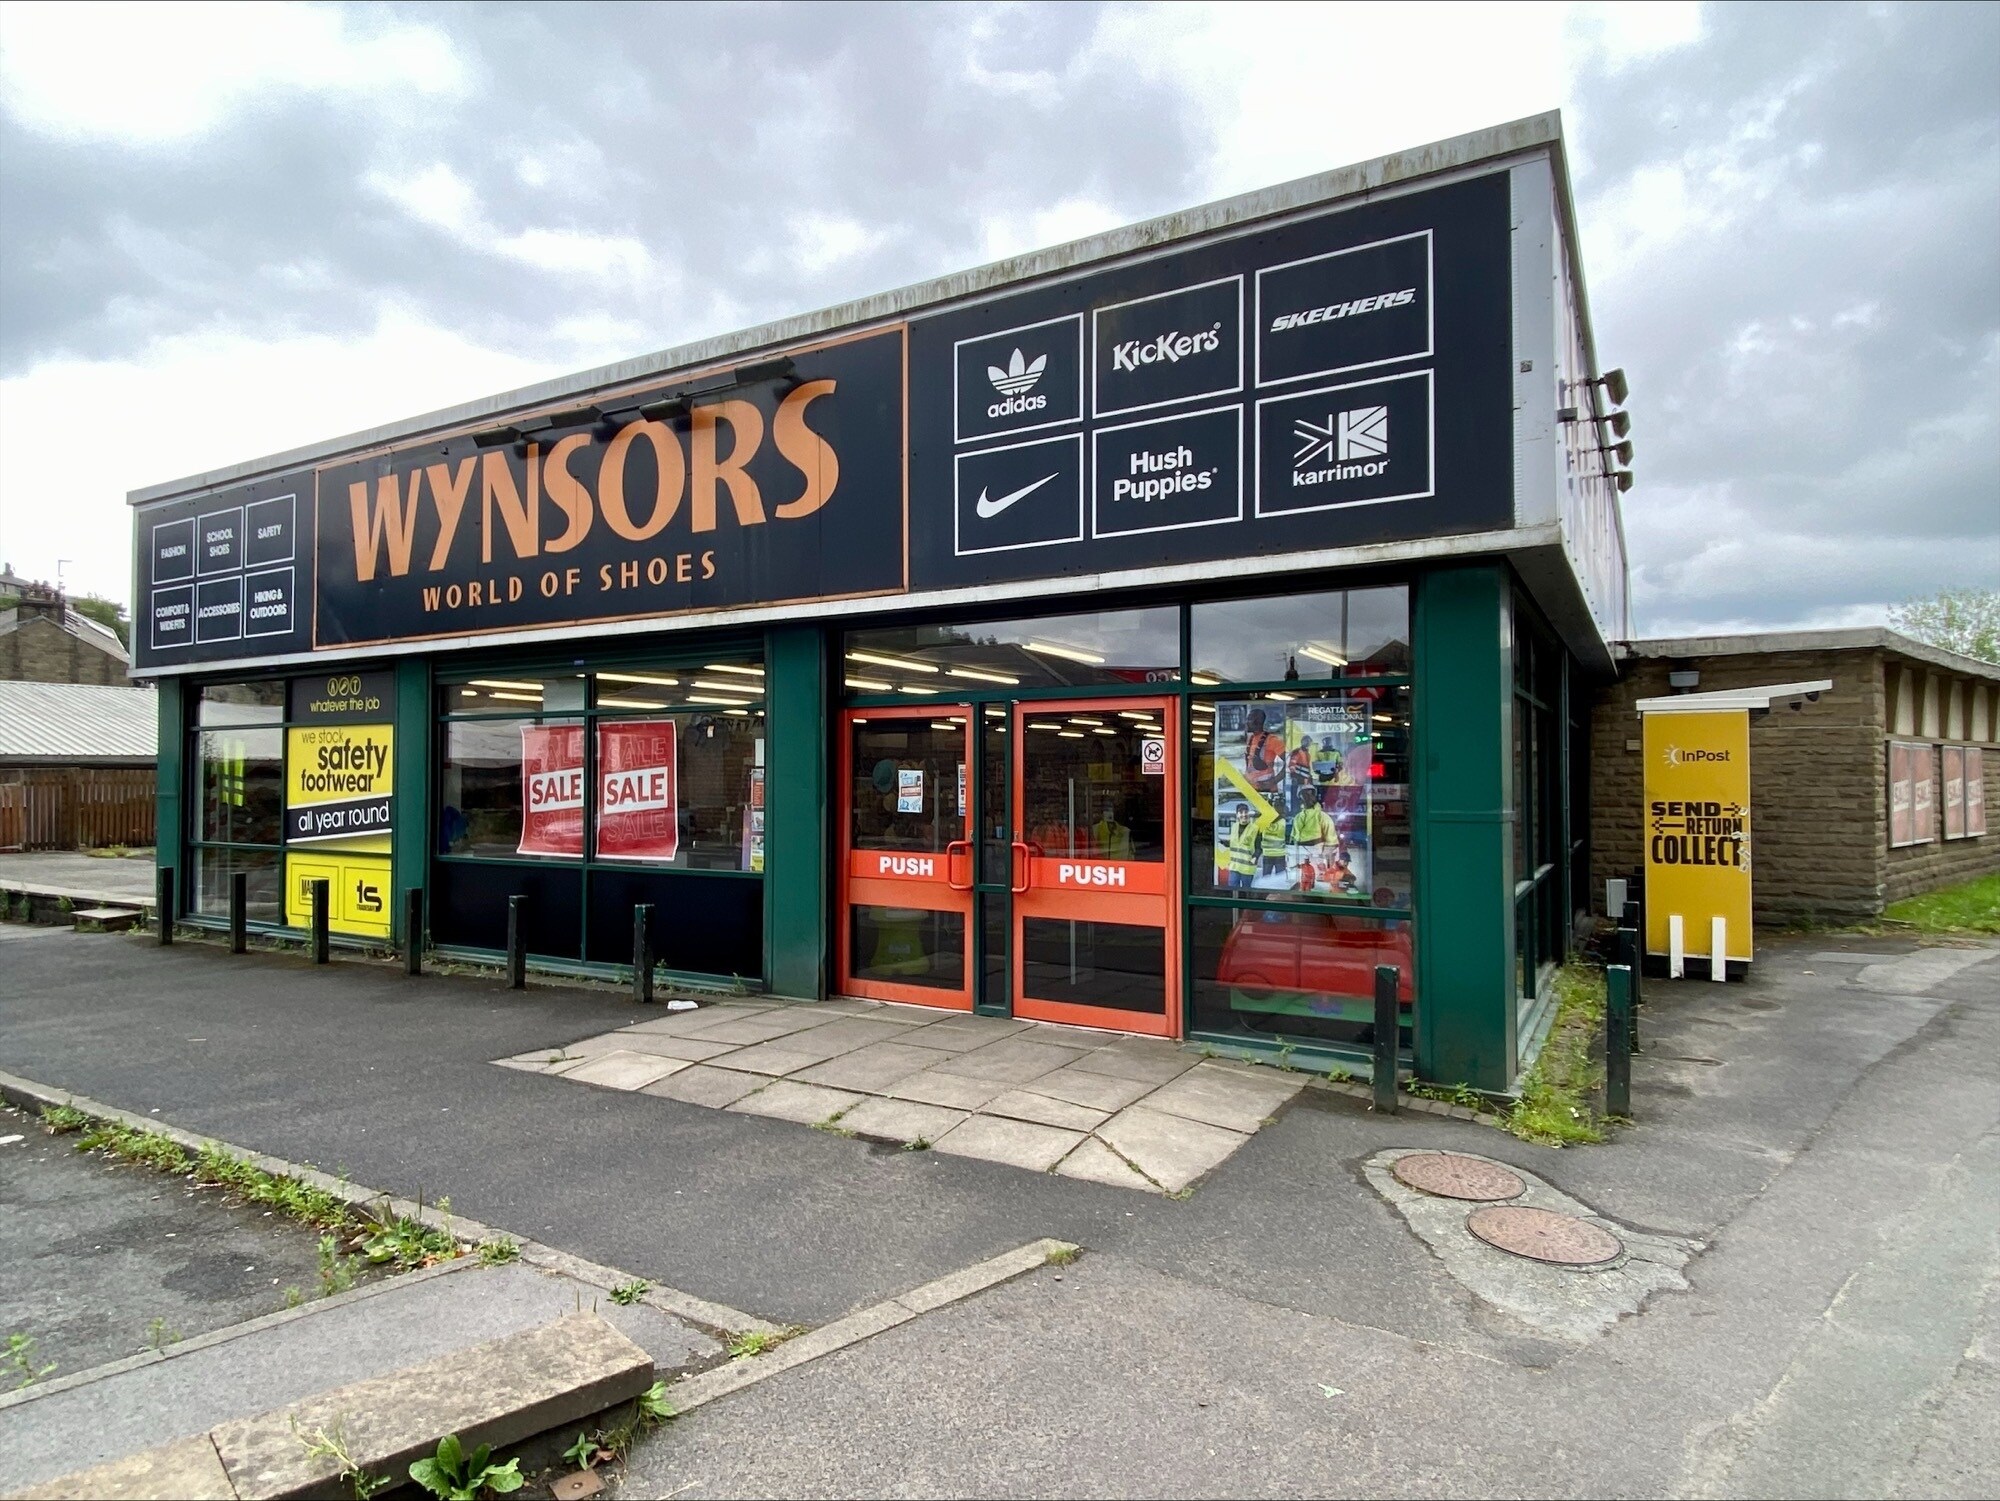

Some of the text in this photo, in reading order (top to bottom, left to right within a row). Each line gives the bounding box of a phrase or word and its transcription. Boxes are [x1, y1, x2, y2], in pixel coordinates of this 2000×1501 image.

[1270, 288, 1416, 332] SKECHERS
[987, 393, 1047, 418] adidas
[1130, 445, 1192, 475] Hush
[349, 379, 840, 582] WYNSORS
[1292, 459, 1387, 487] karrimor
[1114, 470, 1212, 502] Puppies
[206, 528, 233, 543] SCHOOL
[257, 524, 282, 539] SAFETY
[161, 545, 186, 559] FASHION
[209, 543, 230, 557] SHOES
[423, 550, 717, 612] WORLD OF SHOES
[254, 589, 277, 603] HIKING
[155, 604, 184, 618] COMFORT
[198, 602, 240, 618] ACCESSORIES
[250, 603, 287, 619] OUTDOORS
[310, 696, 380, 712] whatever the job
[1308, 706, 1346, 714] REGATTA
[301, 729, 344, 744] we stock
[317, 738, 388, 778] safety
[1682, 750, 1730, 762] InPost
[301, 769, 374, 792] footwear
[531, 774, 582, 805] SALE
[606, 774, 665, 805] SALE
[298, 801, 389, 833] all year round
[1651, 801, 1721, 816] SEND
[606, 810, 667, 842] SALE
[1686, 817, 1742, 835] RETURN
[1652, 835, 1743, 866] COLLECT
[879, 856, 933, 877] PUSH
[1059, 864, 1126, 886] PUSH
